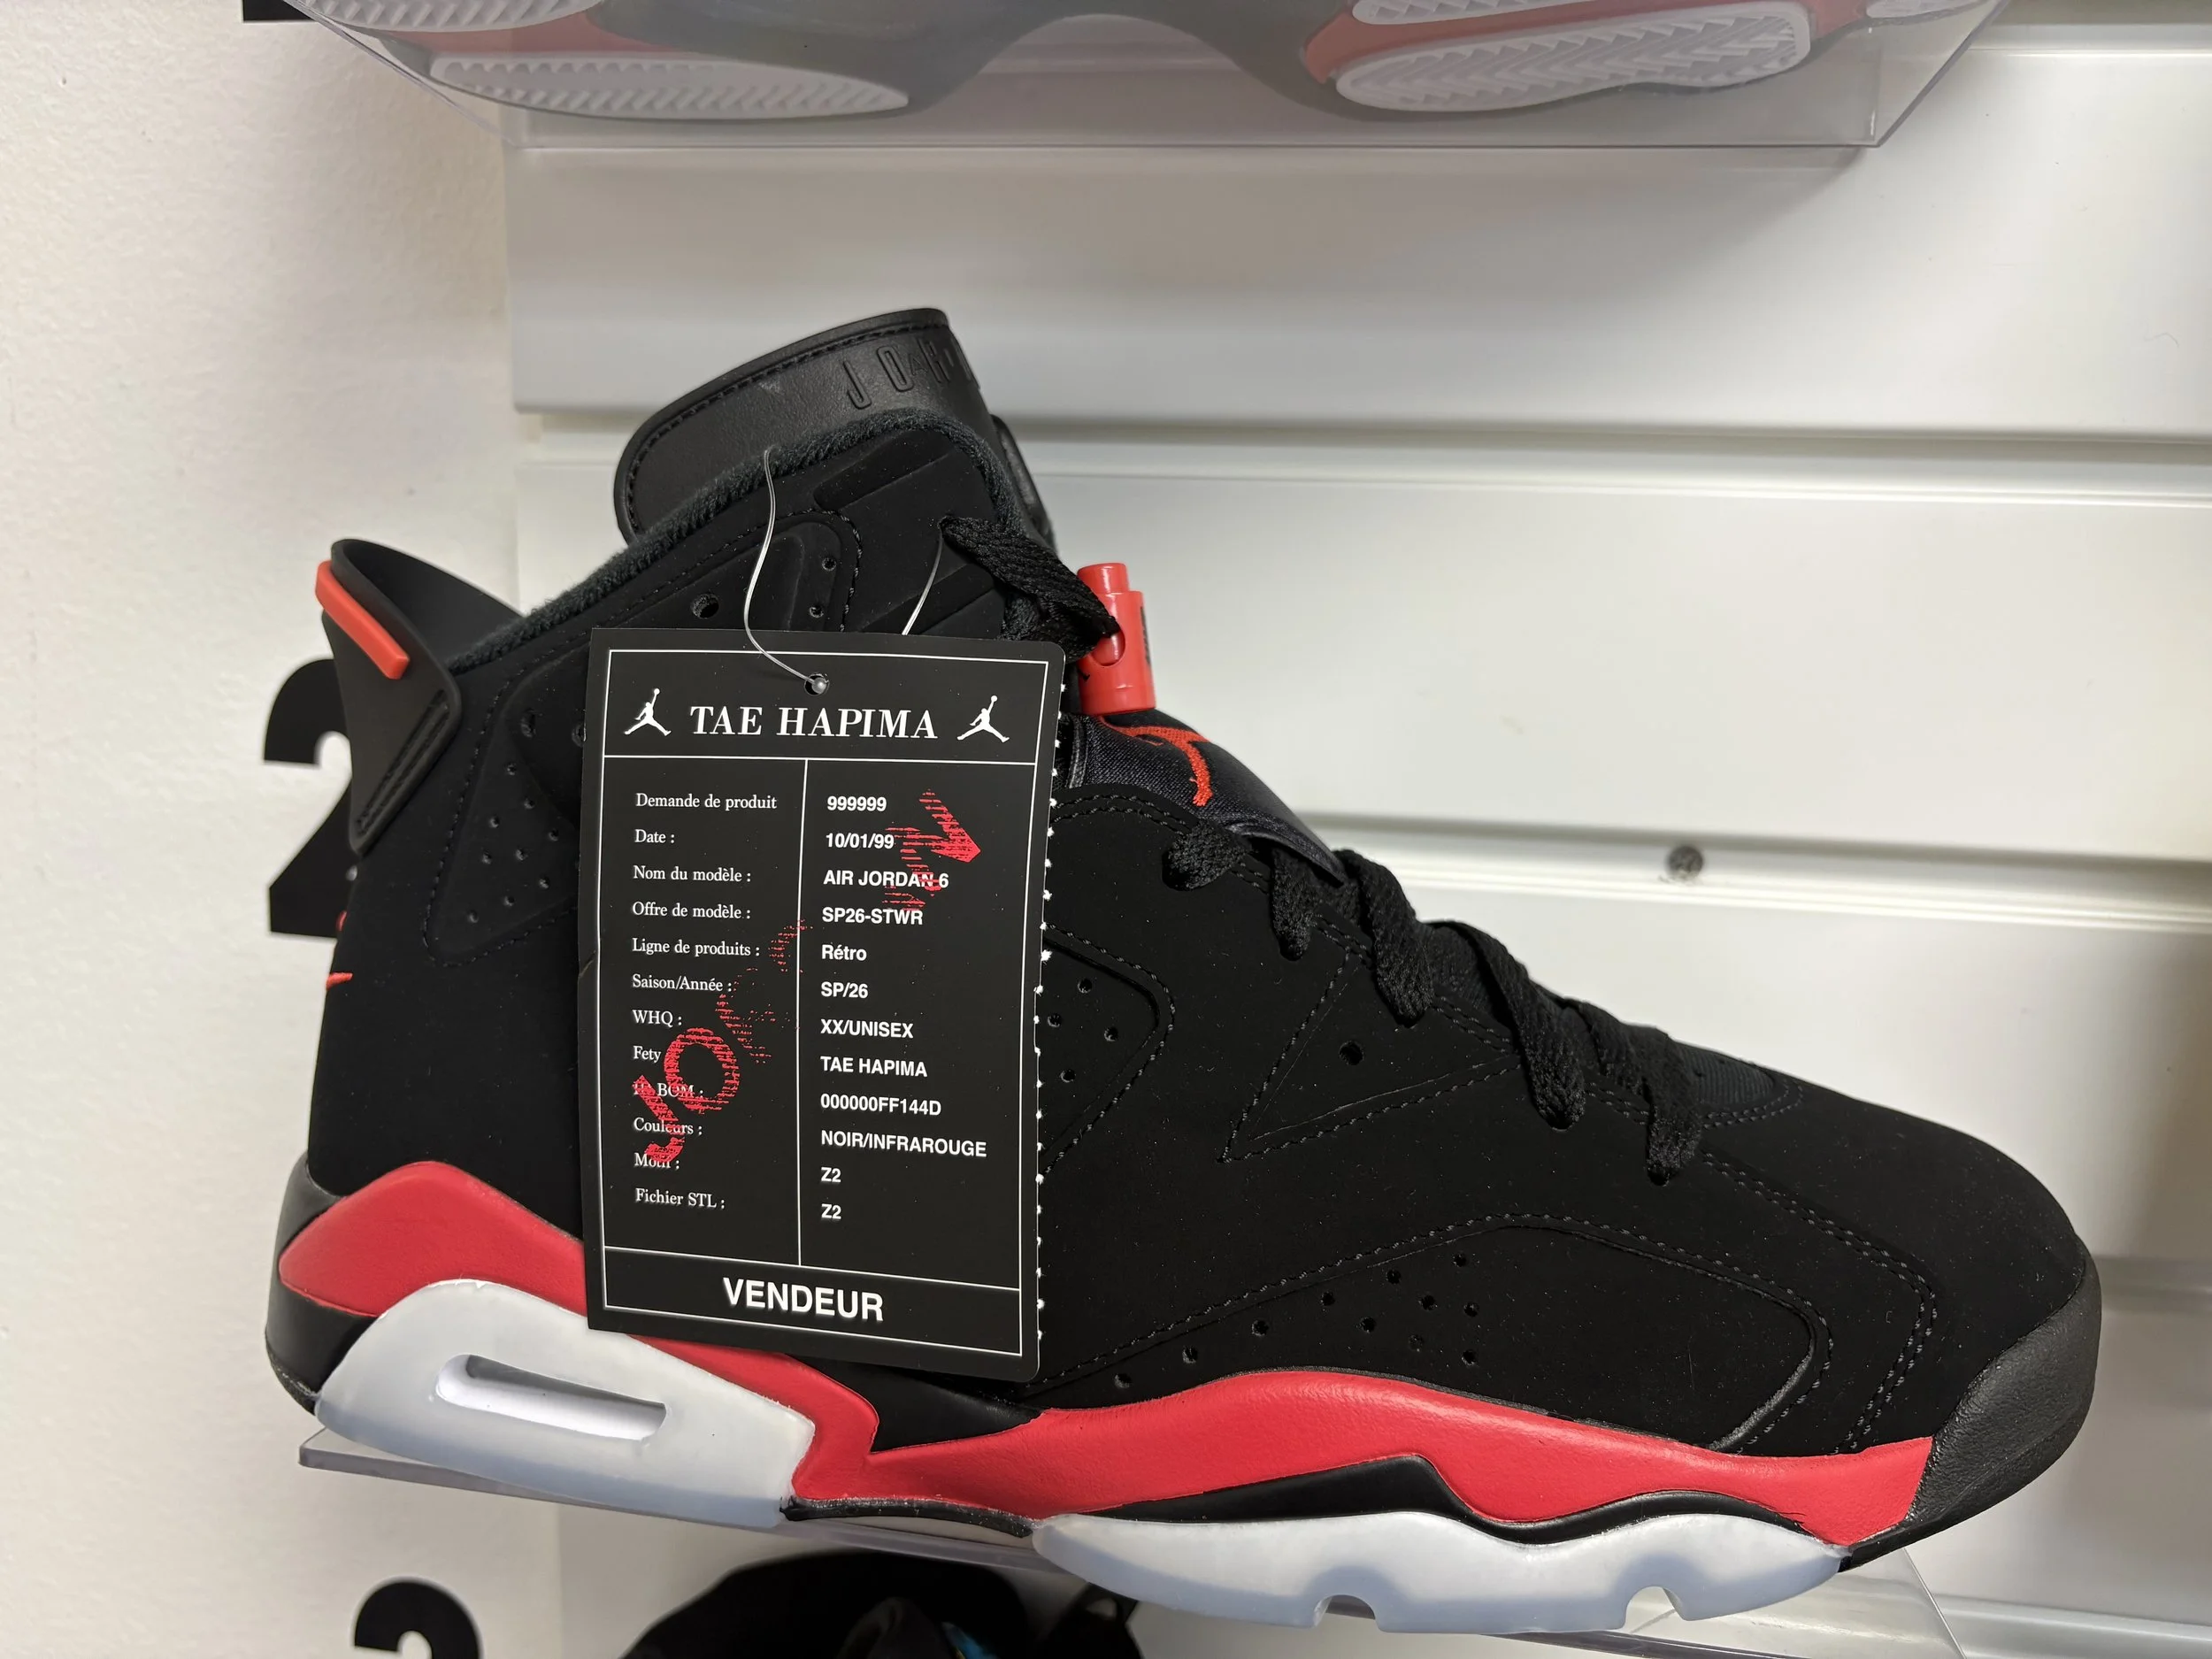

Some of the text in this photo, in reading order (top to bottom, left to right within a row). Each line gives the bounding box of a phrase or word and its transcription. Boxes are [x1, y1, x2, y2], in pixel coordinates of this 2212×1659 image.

[689, 705, 939, 740] TAE HAPIMA
[635, 792, 778, 811] Demande de produit
[826, 795, 887, 812] 999999
[634, 828, 666, 844] Date
[826, 832, 895, 850] 10/01/99
[633, 864, 666, 880] Nom
[670, 865, 688, 880] du
[693, 866, 742, 882] modèle
[823, 869, 949, 889] AIR JORDAN 6
[632, 901, 668, 917] Offre
[672, 902, 688, 918] de
[692, 903, 742, 919] modèle
[821, 908, 925, 926] SP26-STWR
[632, 937, 671, 956] Ligne
[673, 939, 690, 954] de
[695, 941, 751, 957] produits
[821, 944, 867, 962] Rétro
[632, 973, 724, 992] Saison/Année
[820, 980, 869, 999] SP/26
[632, 1009, 673, 1028] WHQ
[820, 1018, 914, 1039] XX/UNISEX
[633, 1045, 662, 1064] Fety
[819, 1056, 928, 1078] TAE HAPIMA
[820, 1093, 942, 1116] 000000FF144D
[821, 1129, 987, 1157] NOIR/INFRAROUGE
[820, 1166, 842, 1183] Z2
[635, 1187, 684, 1205] Fichier
[687, 1192, 718, 1209] STL
[821, 1202, 842, 1220] Z2
[722, 1276, 885, 1322] VENDEUR
